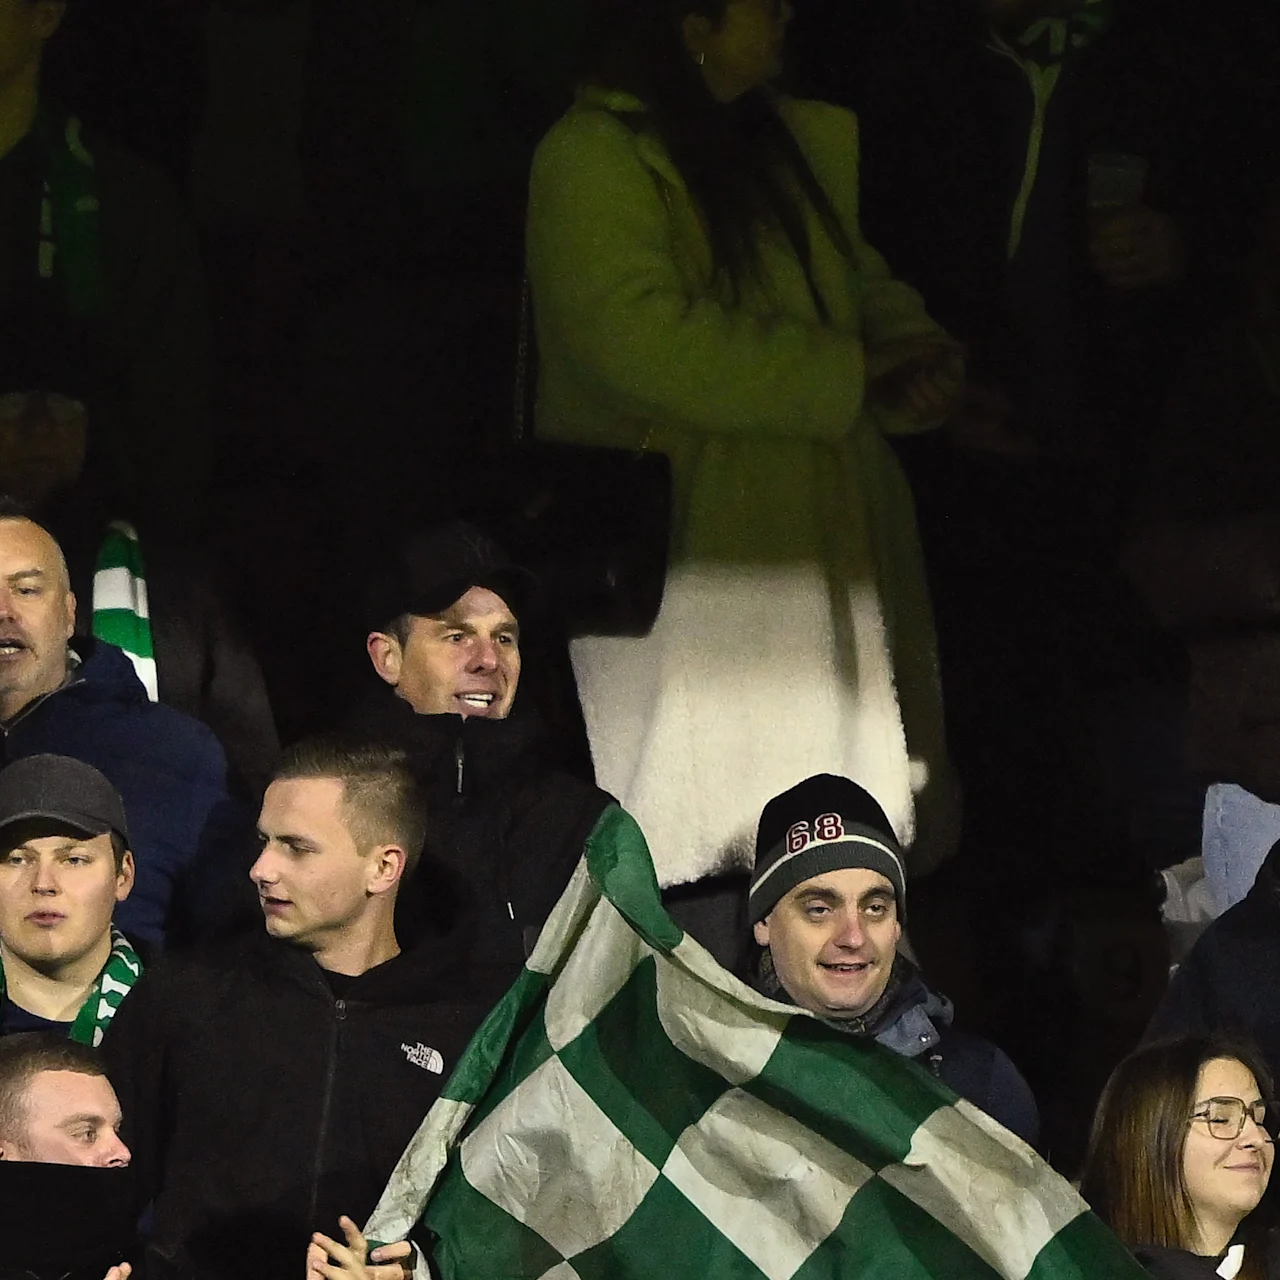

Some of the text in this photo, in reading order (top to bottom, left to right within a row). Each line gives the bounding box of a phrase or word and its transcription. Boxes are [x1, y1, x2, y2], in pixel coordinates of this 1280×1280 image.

[785, 812, 845, 856] 68
[400, 1042, 430, 1061] NORTH
[416, 1041, 433, 1054] THE
[406, 1052, 428, 1069] FACE
